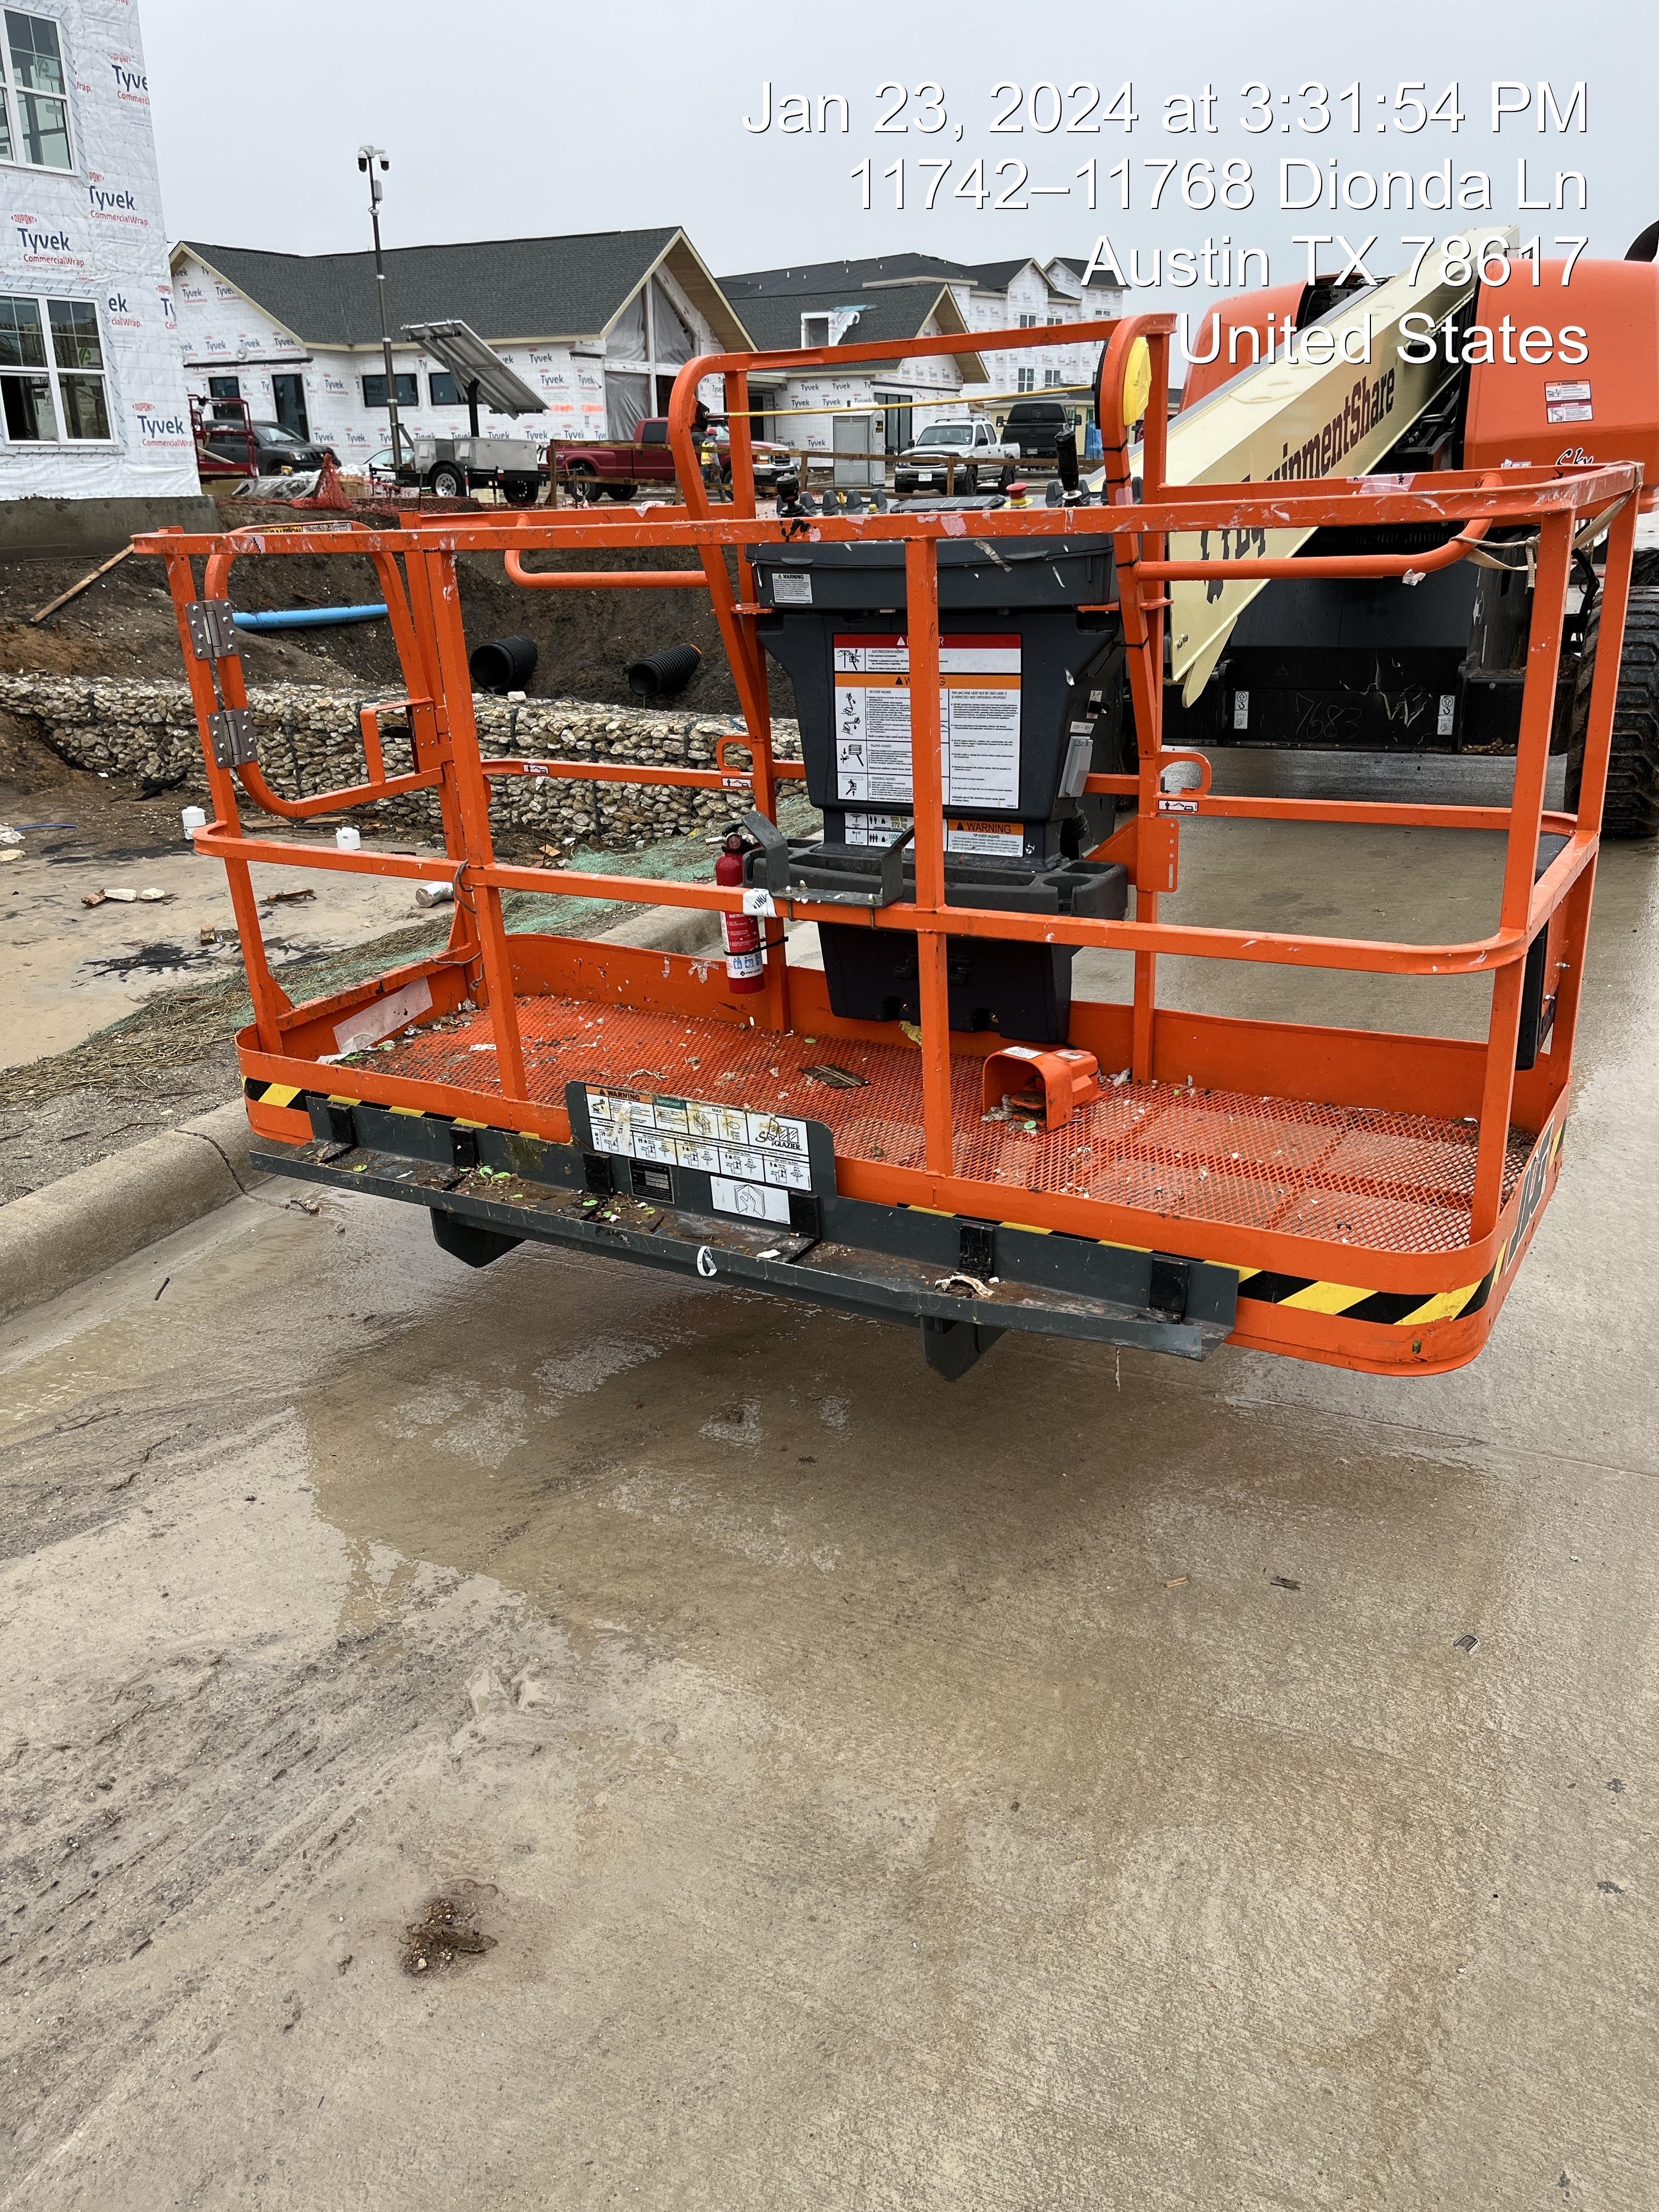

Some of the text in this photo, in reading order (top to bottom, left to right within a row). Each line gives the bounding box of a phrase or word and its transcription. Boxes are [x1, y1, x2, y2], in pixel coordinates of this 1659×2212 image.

[111, 64, 149, 92] Tyve
[117, 91, 150, 106] Commerci
[89, 185, 137, 211] Tyvek
[11, 214, 37, 225] DUPONT
[91, 210, 149, 227] CommercialWrap
[17, 227, 71, 254] Tyvek
[24, 254, 85, 267] CommercialWrap
[182, 288, 202, 297] Tyvek
[180, 342, 194, 351] vek
[206, 341, 227, 351] Tyvek
[274, 338, 295, 347] Tyvek
[529, 353, 553, 364] Tyvek
[325, 380, 344, 390] Tyvek
[540, 375, 564, 386] Tyvek
[791, 399, 810, 408] Tyvek
[822, 398, 841, 407] Tyvek
[137, 415, 184, 438] Tyvek
[314, 432, 335, 443] Tyvek
[347, 433, 366, 443] Tyvek
[526, 431, 548, 439] Tyvek
[565, 430, 585, 440] Tyvek
[142, 438, 193, 448] CommercialWra
[808, 439, 826, 448] Tyvek
[967, 822, 1011, 834] WARNING
[607, 1090, 640, 1101] WARNING
[656, 1099, 681, 1108] IMPORTANT
[1504, 1114, 1556, 1276] JLG
